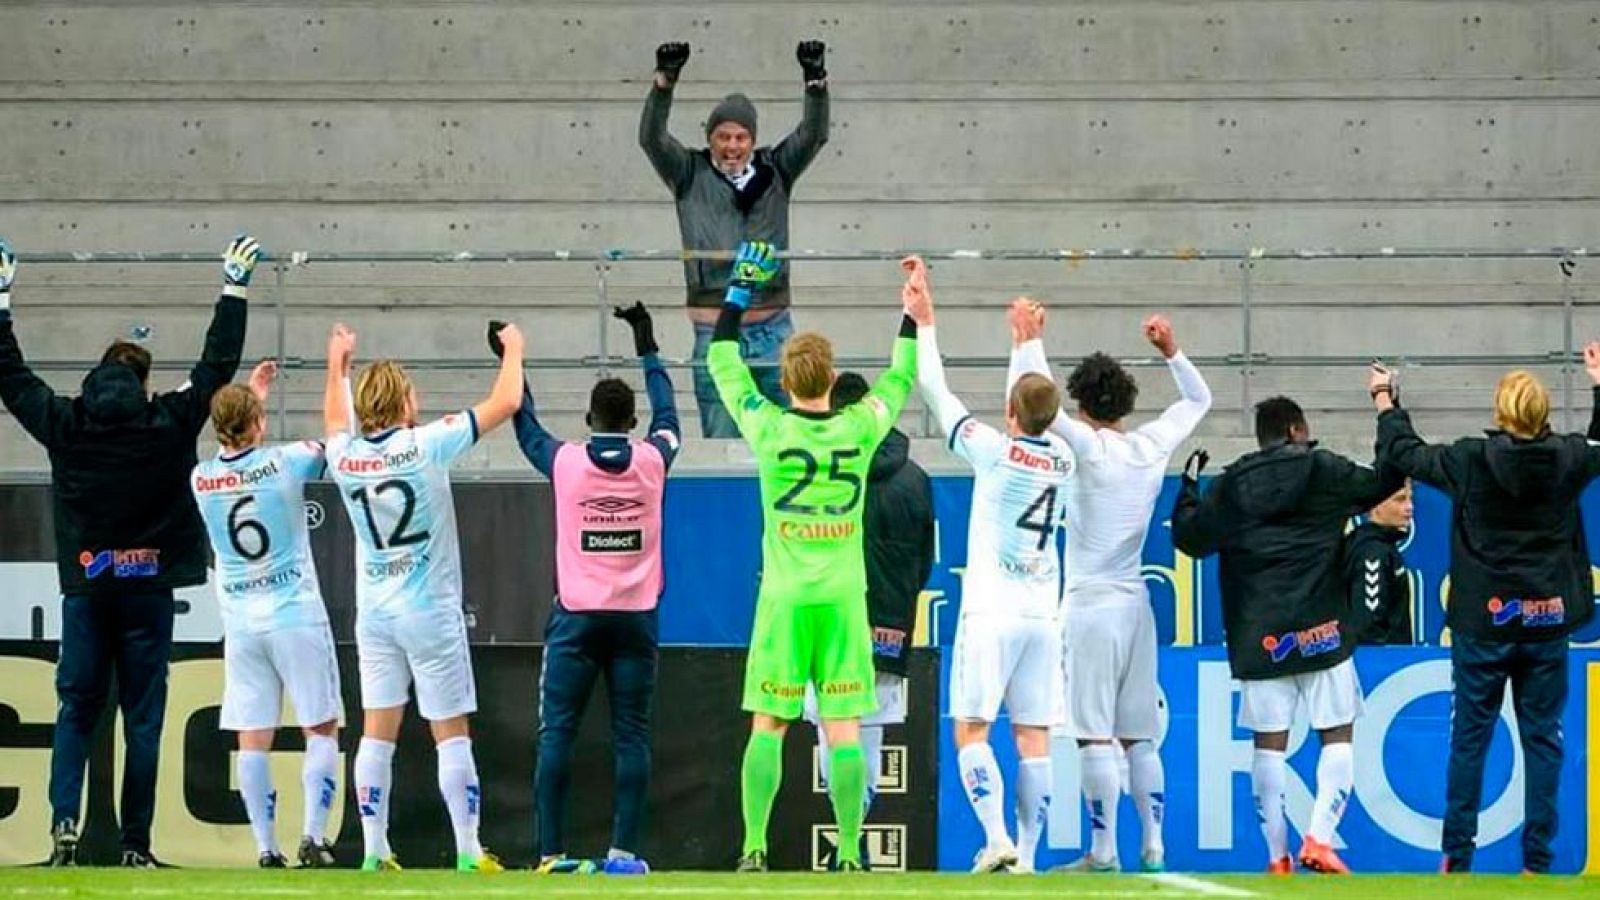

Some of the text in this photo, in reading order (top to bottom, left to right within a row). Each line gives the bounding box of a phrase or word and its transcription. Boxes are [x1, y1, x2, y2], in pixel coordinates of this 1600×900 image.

[350, 479, 431, 550] 12
[774, 448, 862, 516] 25
[227, 494, 270, 561] 6
[780, 521, 855, 539] Canon
[1016, 484, 1057, 551] 4
